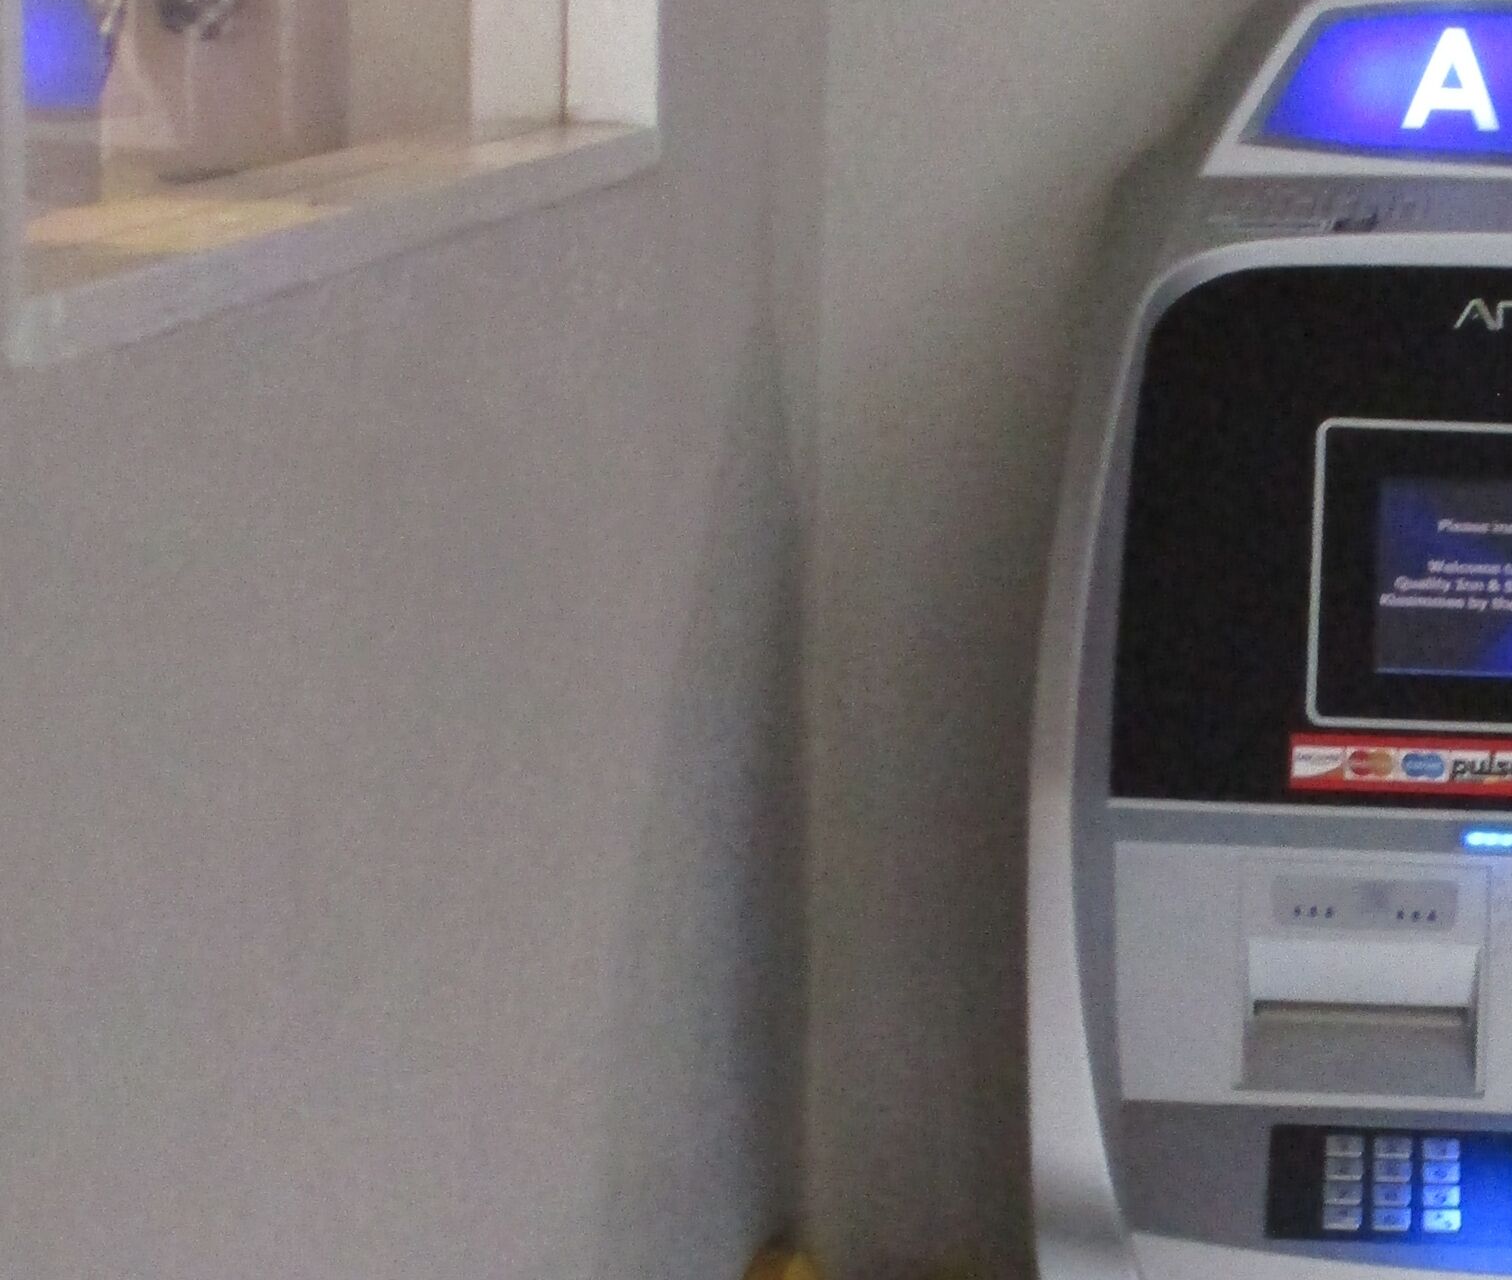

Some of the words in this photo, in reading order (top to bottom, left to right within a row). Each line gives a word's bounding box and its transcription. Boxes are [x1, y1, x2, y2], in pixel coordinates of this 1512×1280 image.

[1427, 559, 1501, 575] Welcome
[1394, 576, 1451, 593] Quality
[1487, 578, 1501, 593] &
